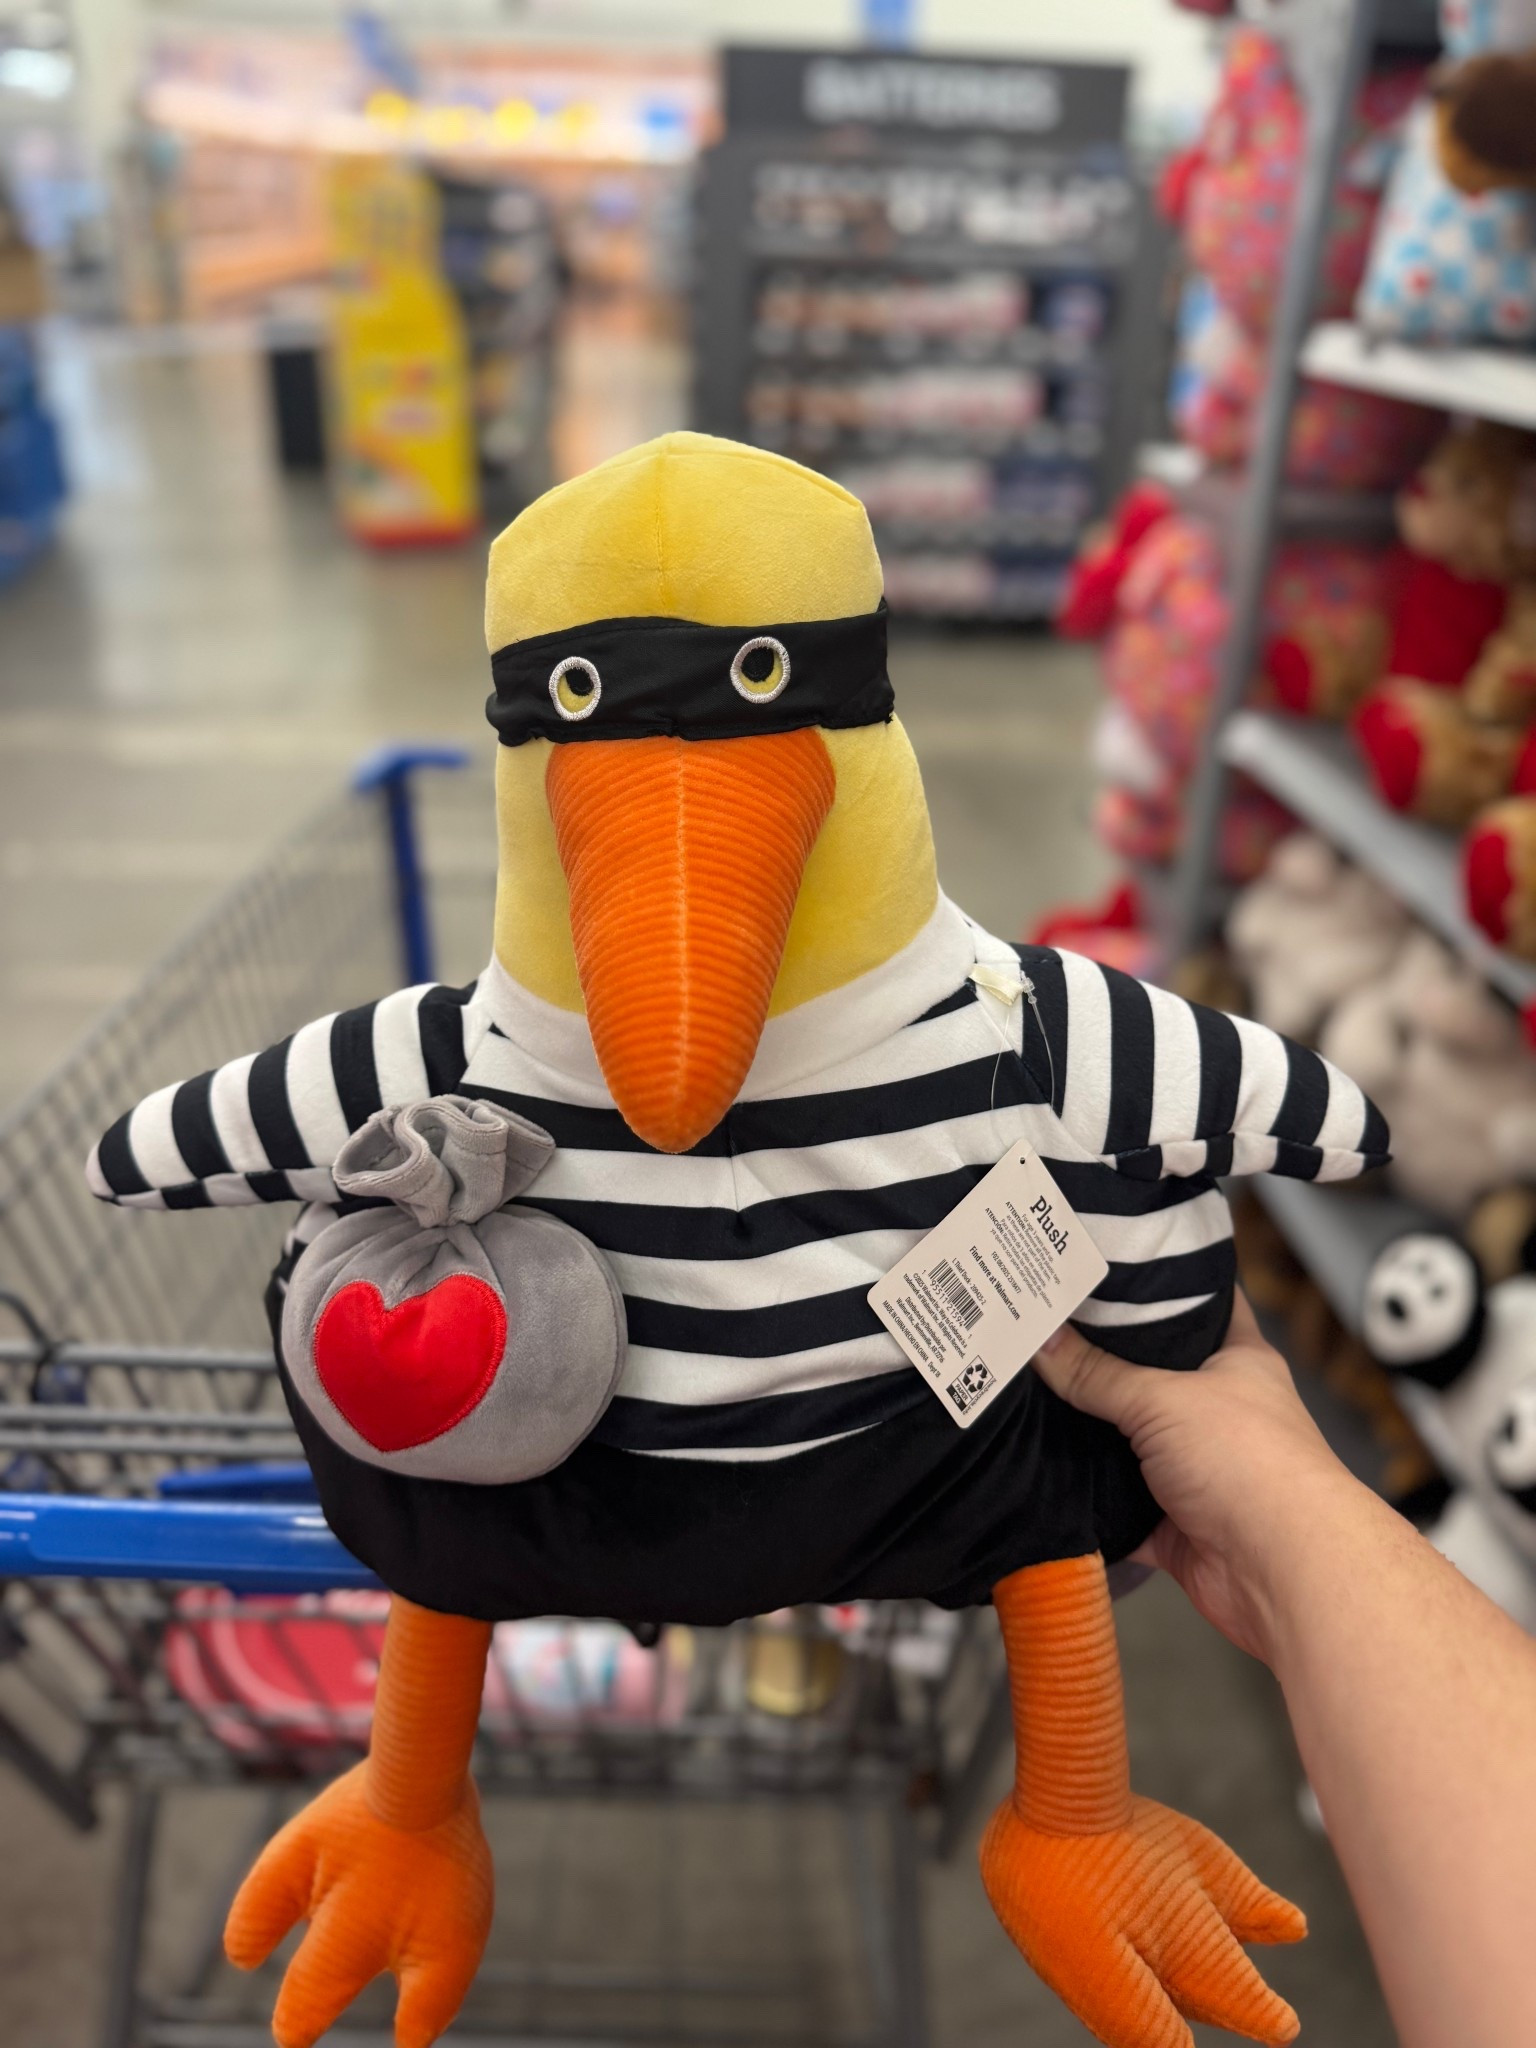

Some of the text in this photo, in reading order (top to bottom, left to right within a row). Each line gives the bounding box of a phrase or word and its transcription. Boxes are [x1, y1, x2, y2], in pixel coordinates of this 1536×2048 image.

[985, 1208, 1004, 1235] ATENCIÓN:
[1003, 1233, 1012, 1247] Retire
[1011, 1246, 1021, 1260] todas
[1023, 1265, 1038, 1286] etiquetas
[995, 1234, 1003, 1244] que
[1010, 1258, 1020, 1271] parte
[1001, 1218, 1009, 1230] Para
[1007, 1229, 1017, 1242] niños
[1022, 1252, 1030, 1263] años
[1005, 1201, 1026, 1231] ATTENTION:
[1024, 1229, 1037, 1248] Remove
[1043, 1260, 1055, 1275] plastic
[1010, 1219, 1020, 1233] these
[1028, 1247, 1037, 1258] part
[1029, 1195, 1069, 1255] Plush
[1034, 1234, 1044, 1247] years
[1042, 1246, 1050, 1256] and
[955, 1261, 965, 1274] Thief
[961, 1271, 971, 1284] Duck
[969, 1245, 1020, 1320] Find more at Walmart.com
[896, 1297, 911, 1317] Walmart
[930, 1345, 937, 1353] AR
[903, 1273, 920, 1296] trademark
[921, 1297, 935, 1317] Walmart
[941, 1326, 952, 1341] Rights
[950, 1338, 966, 1359] Reserved.
[905, 1296, 946, 1352] Distributed by/Distribuido por
[922, 1285, 936, 1304] Walmart
[939, 1309, 947, 1320] Way
[948, 1322, 963, 1342] Celebrate
[930, 1279, 948, 1304] 95511
[946, 1303, 964, 1327] 21594
[883, 1300, 894, 1314] MADE
[894, 1316, 916, 1344] CHINA/HECHO
[913, 1342, 920, 1350] EN
[917, 1347, 929, 1362] CHINA
[928, 1361, 937, 1374] Dept
[953, 1392, 961, 1404] TAG
[955, 1384, 968, 1401] PAPER
